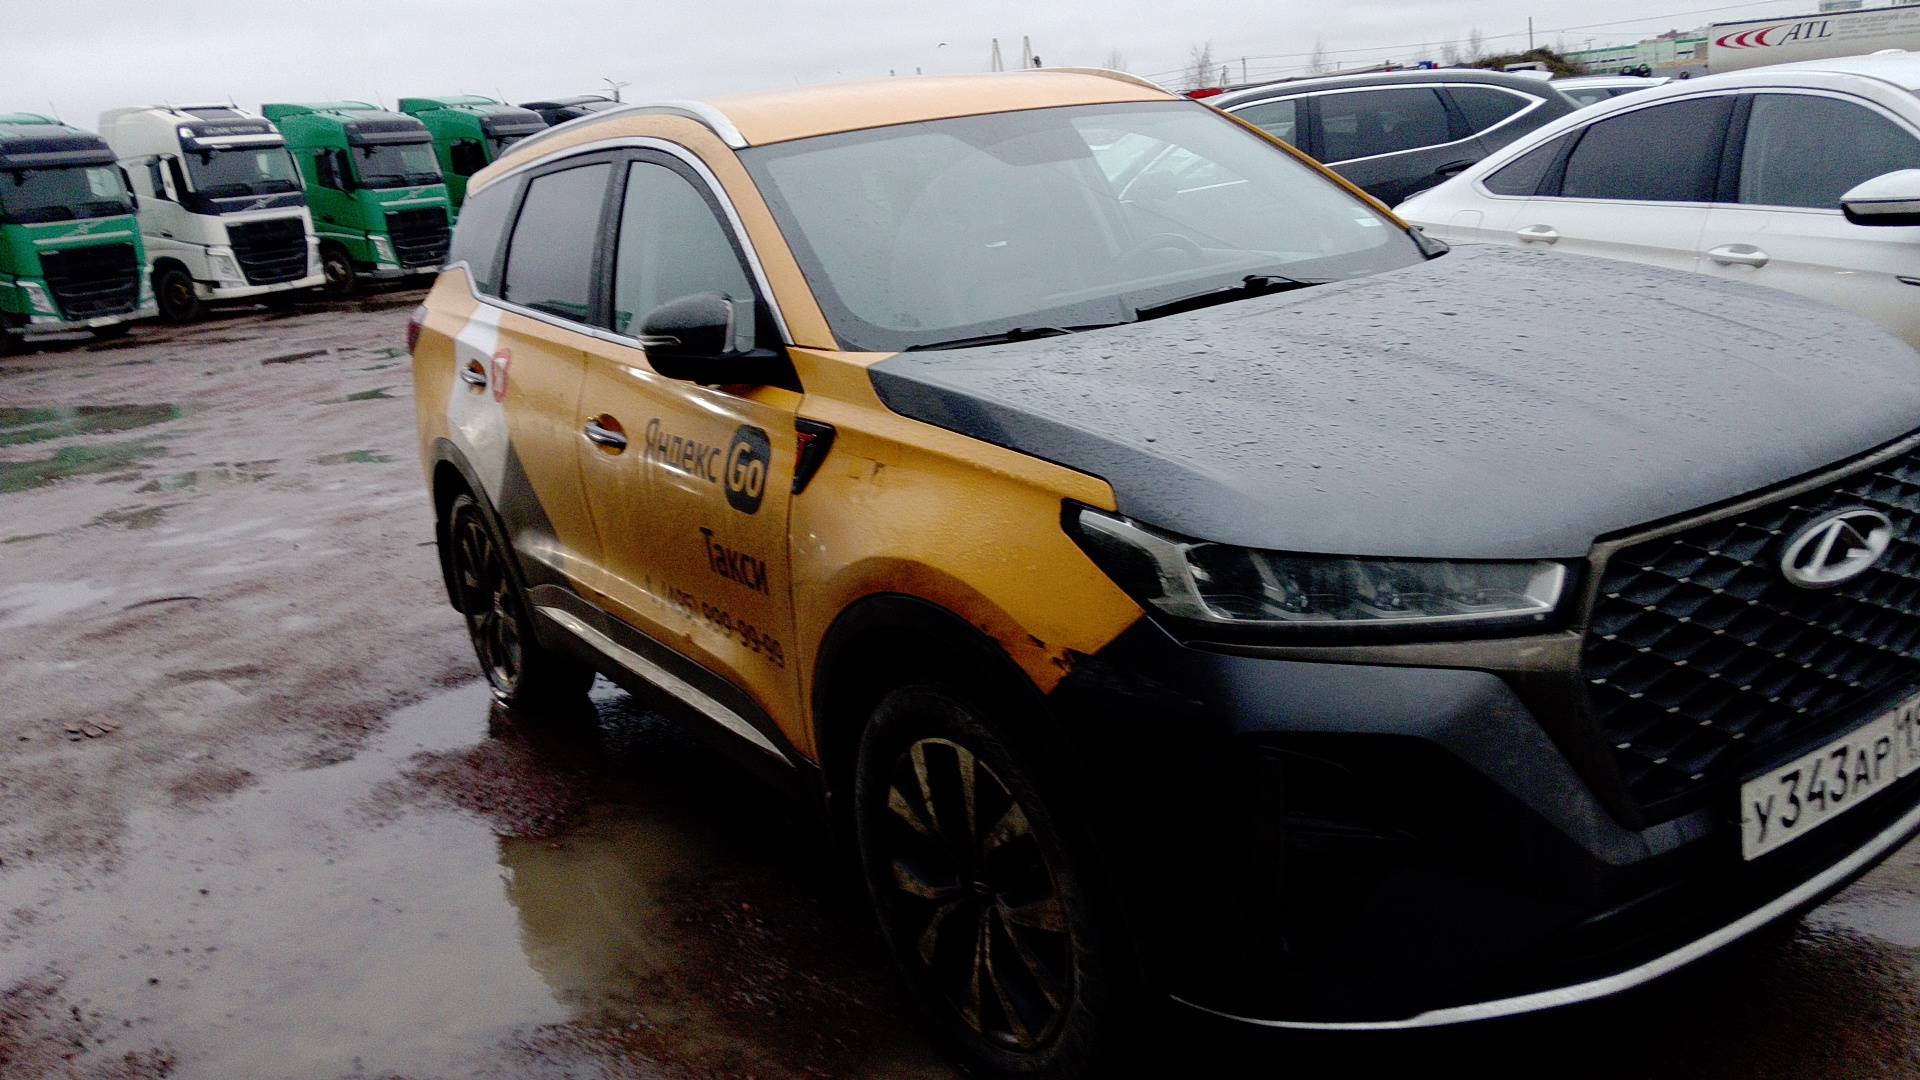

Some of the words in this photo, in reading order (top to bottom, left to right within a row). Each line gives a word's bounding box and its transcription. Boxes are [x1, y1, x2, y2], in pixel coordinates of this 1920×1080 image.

[1777, 19, 1833, 46] ATL
[644, 418, 721, 484] Яндекс
[728, 441, 765, 498] Go
[699, 526, 770, 596] Такси
[1754, 735, 1891, 844] У343АР
